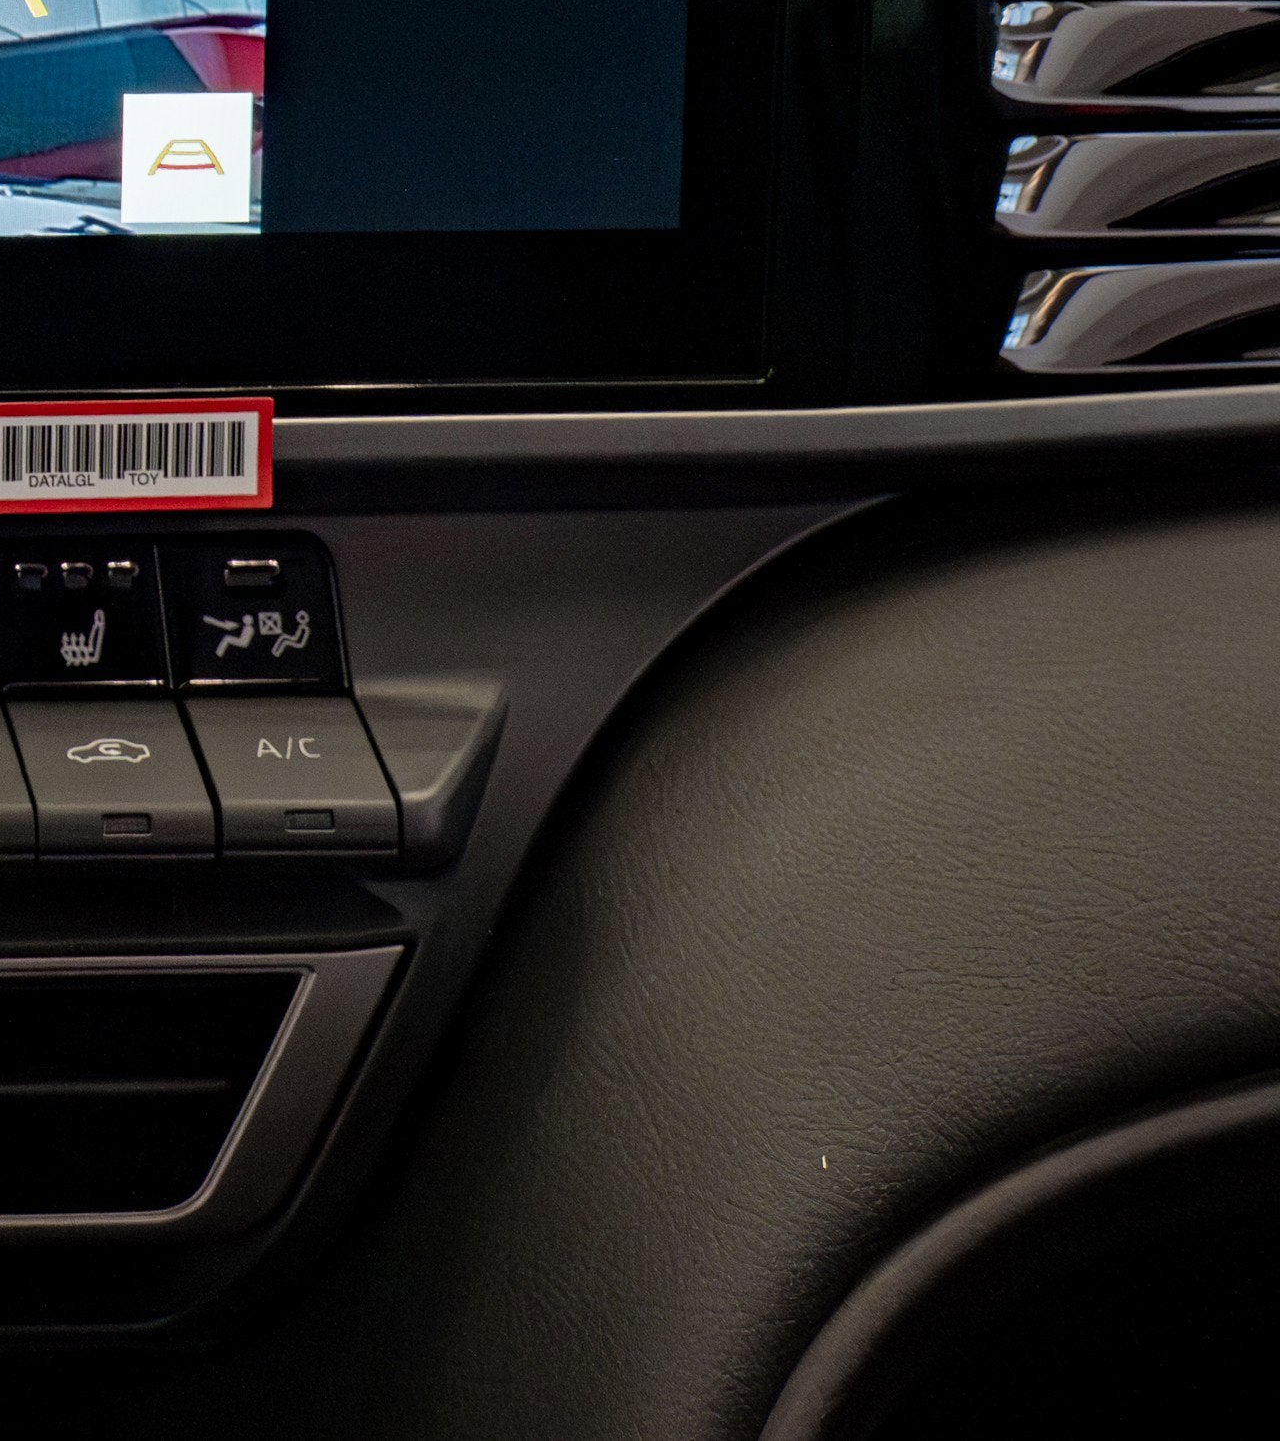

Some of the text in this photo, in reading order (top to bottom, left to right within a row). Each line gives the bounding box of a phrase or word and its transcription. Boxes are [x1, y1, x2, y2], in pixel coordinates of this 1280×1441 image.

[29, 473, 95, 488] DATALGL
[129, 472, 160, 486] TOY
[256, 738, 321, 759] A/C
